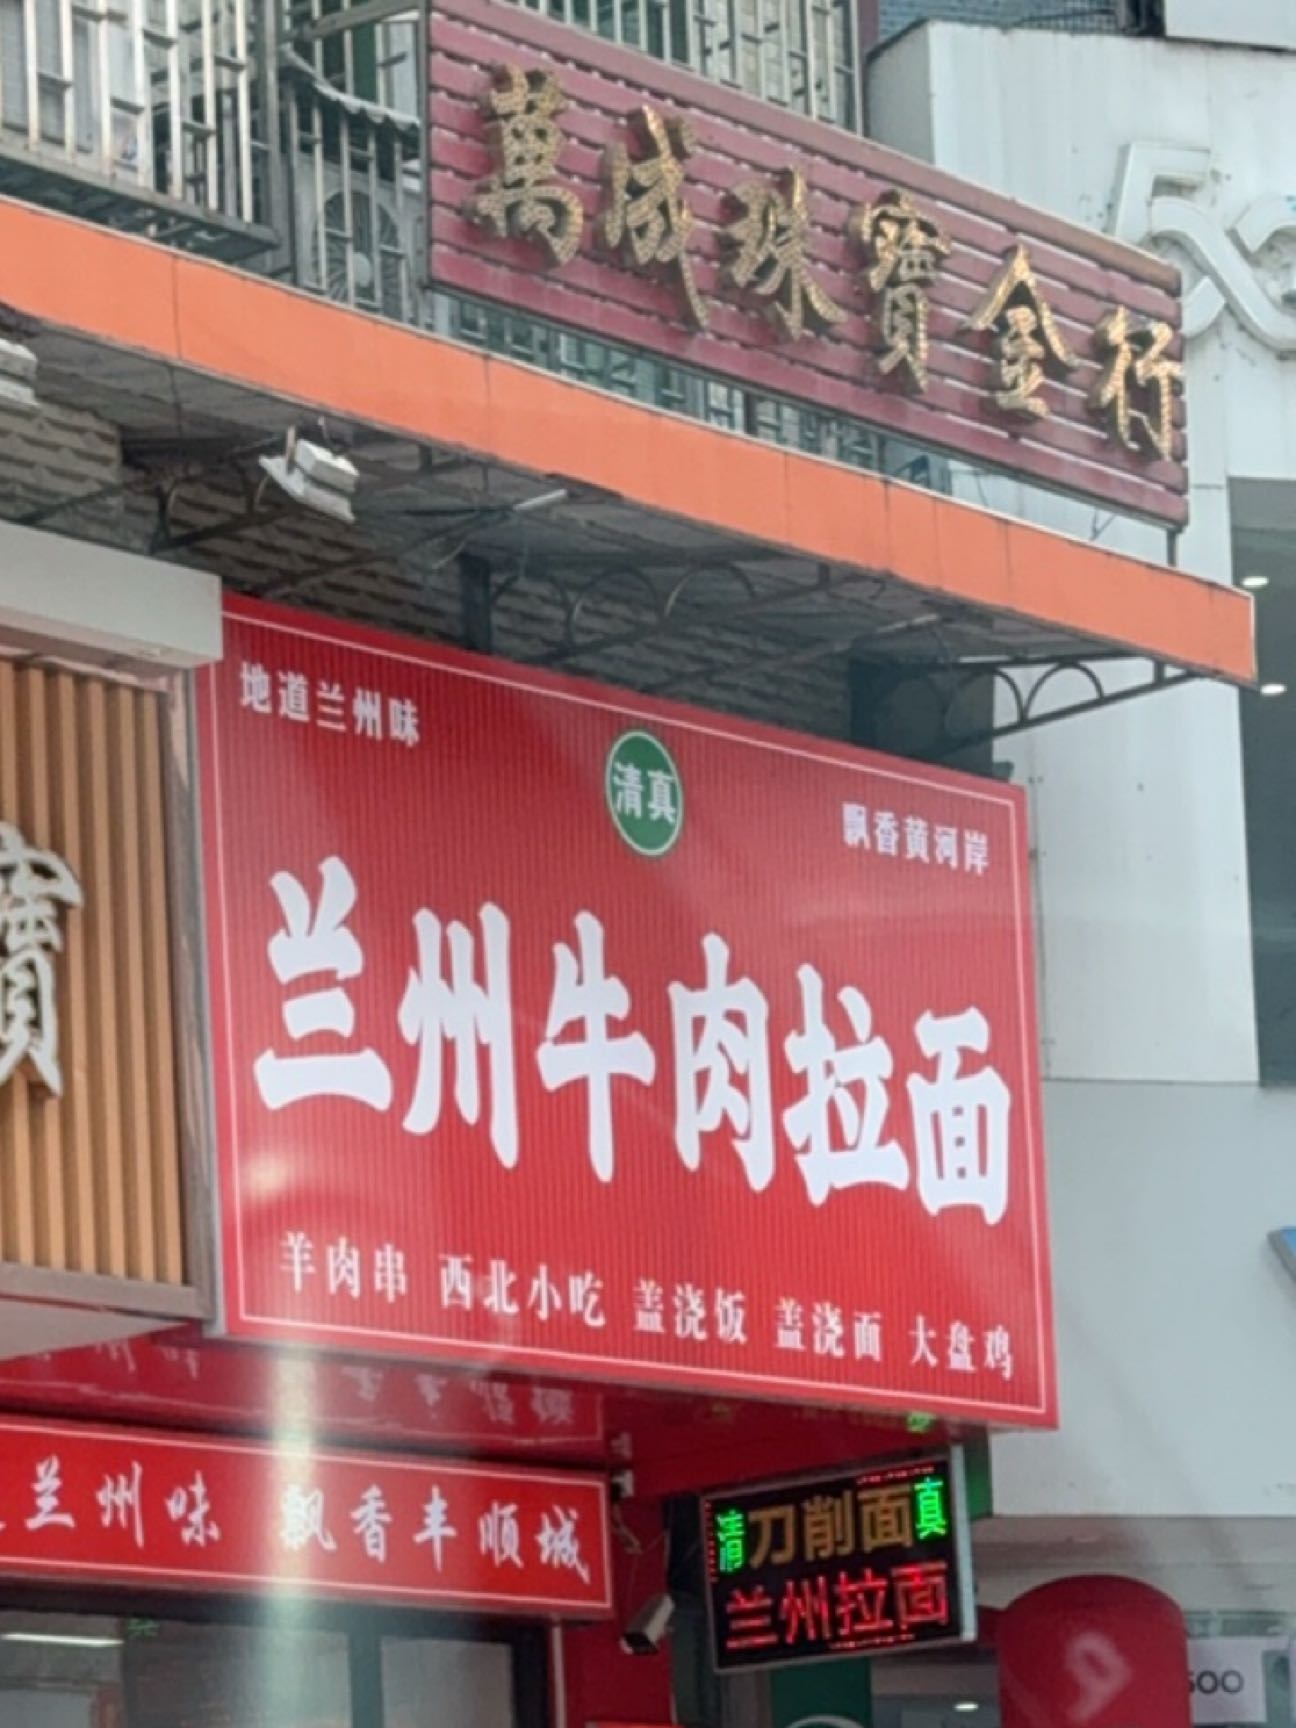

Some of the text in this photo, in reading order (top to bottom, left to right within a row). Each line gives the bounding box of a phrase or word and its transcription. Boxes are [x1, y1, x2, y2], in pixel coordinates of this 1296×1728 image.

[239, 662, 420, 749] 地道兰州味
[614, 762, 678, 825] 清真
[841, 803, 990, 876] 飘香黄河岸
[253, 856, 1011, 1227] 兰州牛肉拉面
[278, 1230, 1014, 1382] 羊肉串 西北小吃 盖浇饭 盖浇面 大盘鸡
[280, 1481, 593, 1586] 飘香丰顺城
[748, 1483, 913, 1569] 刀削面
[913, 1476, 949, 1540] 真
[726, 1561, 949, 1650] 兰州拉面
